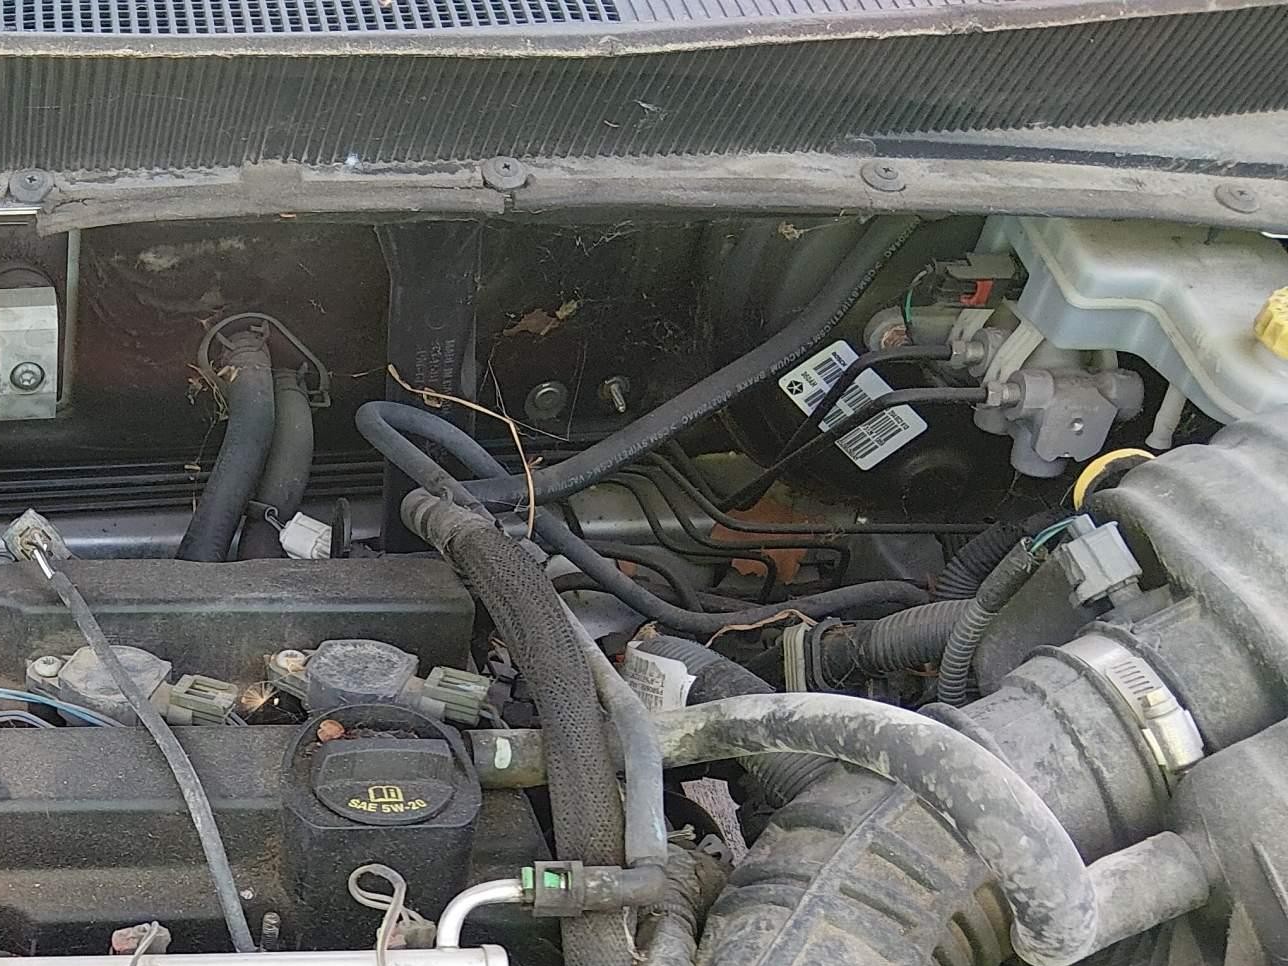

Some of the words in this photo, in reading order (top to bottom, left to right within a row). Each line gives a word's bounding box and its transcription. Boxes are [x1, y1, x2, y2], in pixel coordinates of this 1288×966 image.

[767, 343, 808, 375] VACUUM
[347, 798, 377, 813] SAE
[381, 799, 427, 814] 5W-20
